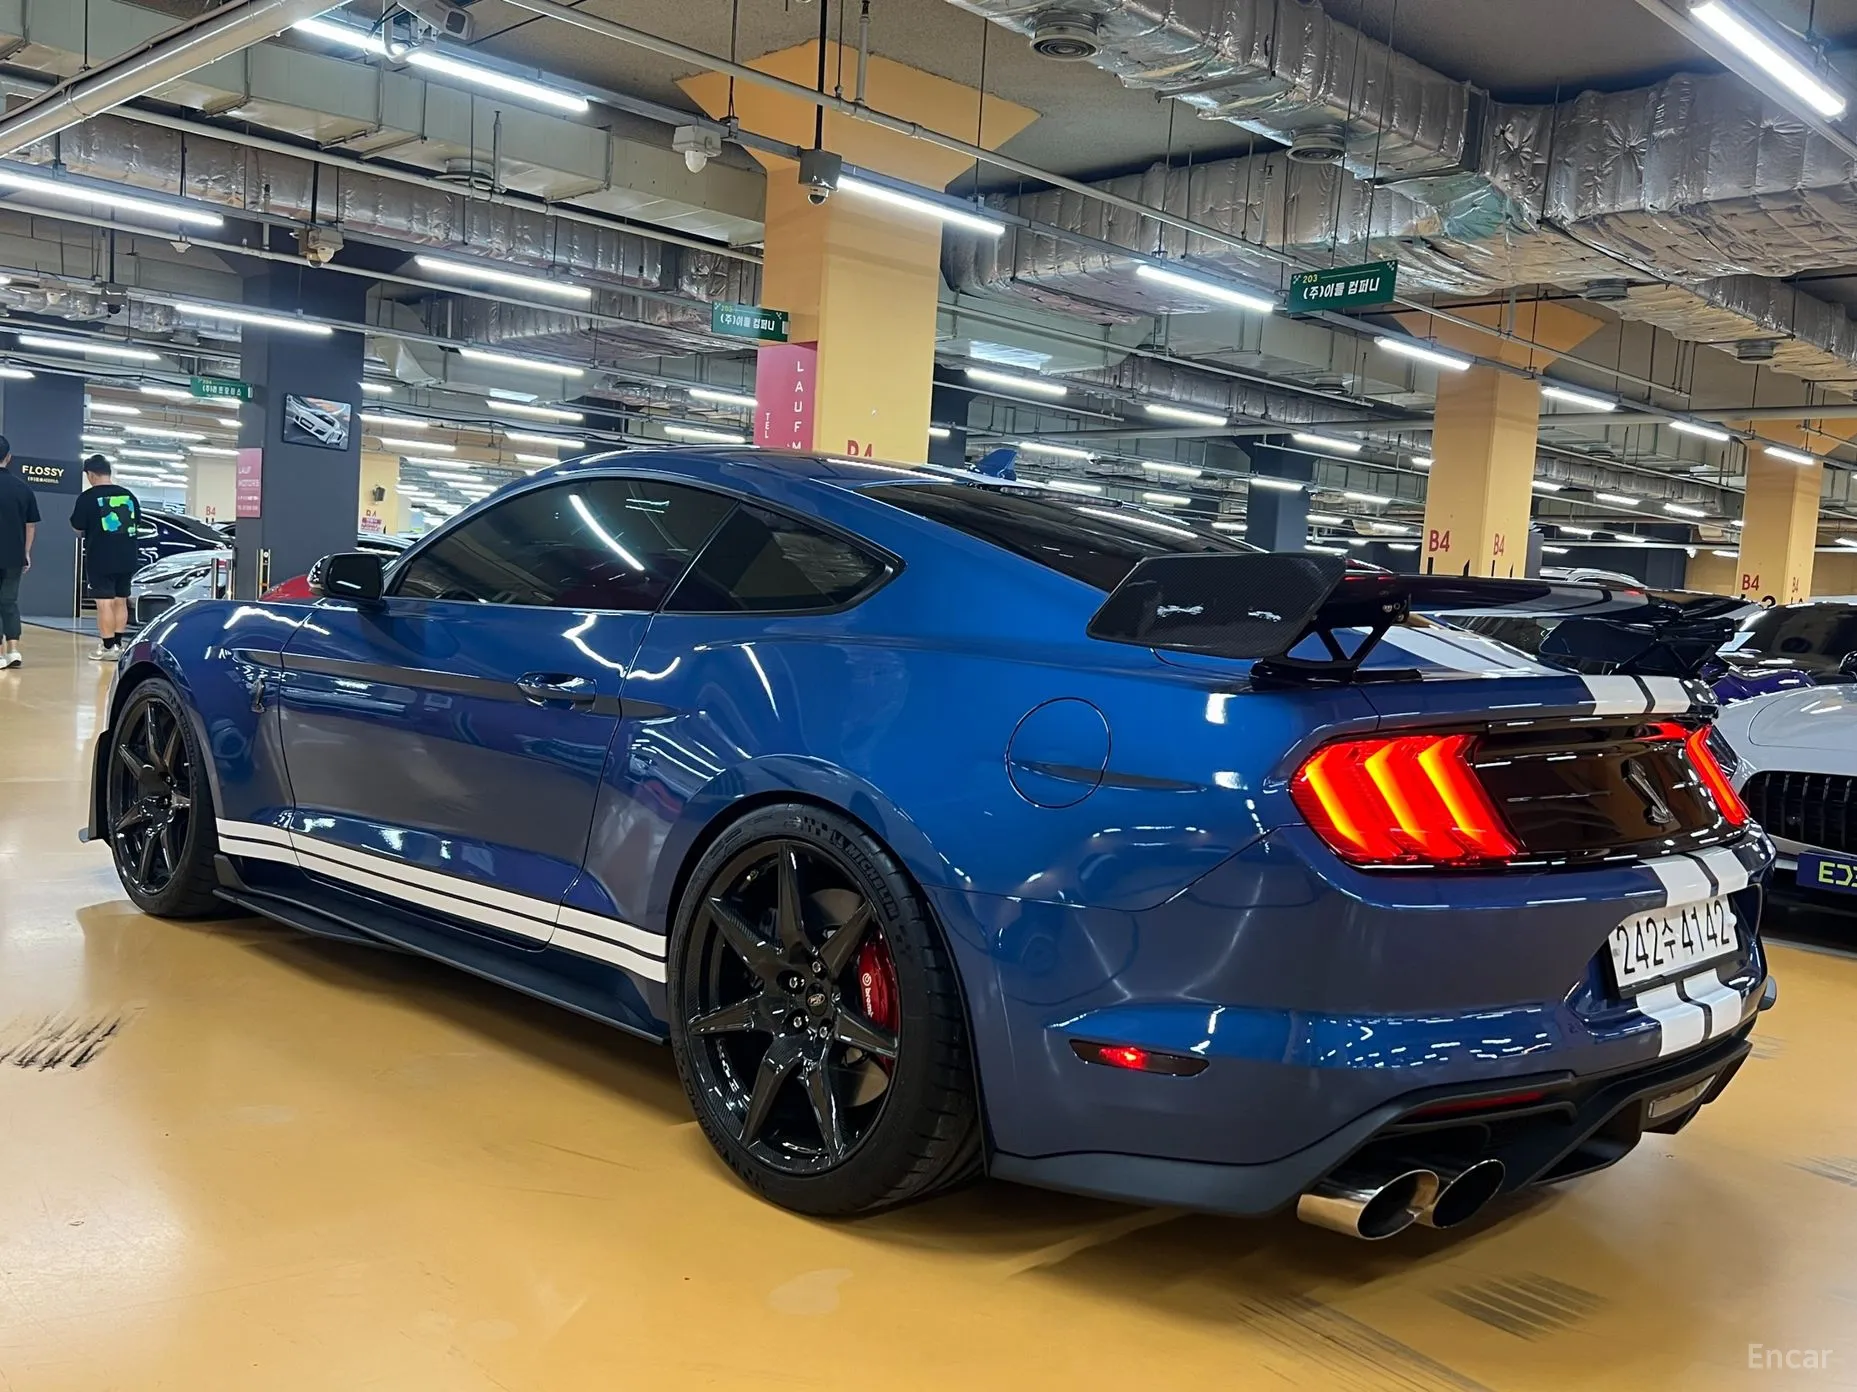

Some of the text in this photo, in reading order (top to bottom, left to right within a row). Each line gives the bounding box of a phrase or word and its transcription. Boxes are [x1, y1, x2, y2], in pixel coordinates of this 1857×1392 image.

[1302, 274, 1318, 284] 203
[1348, 277, 1380, 295] 컴퍼니
[22, 464, 64, 477] FLOSSY
[205, 505, 216, 516] B4
[1428, 529, 1450, 553] B4
[1493, 533, 1505, 556] B4
[1741, 573, 1760, 591] B4
